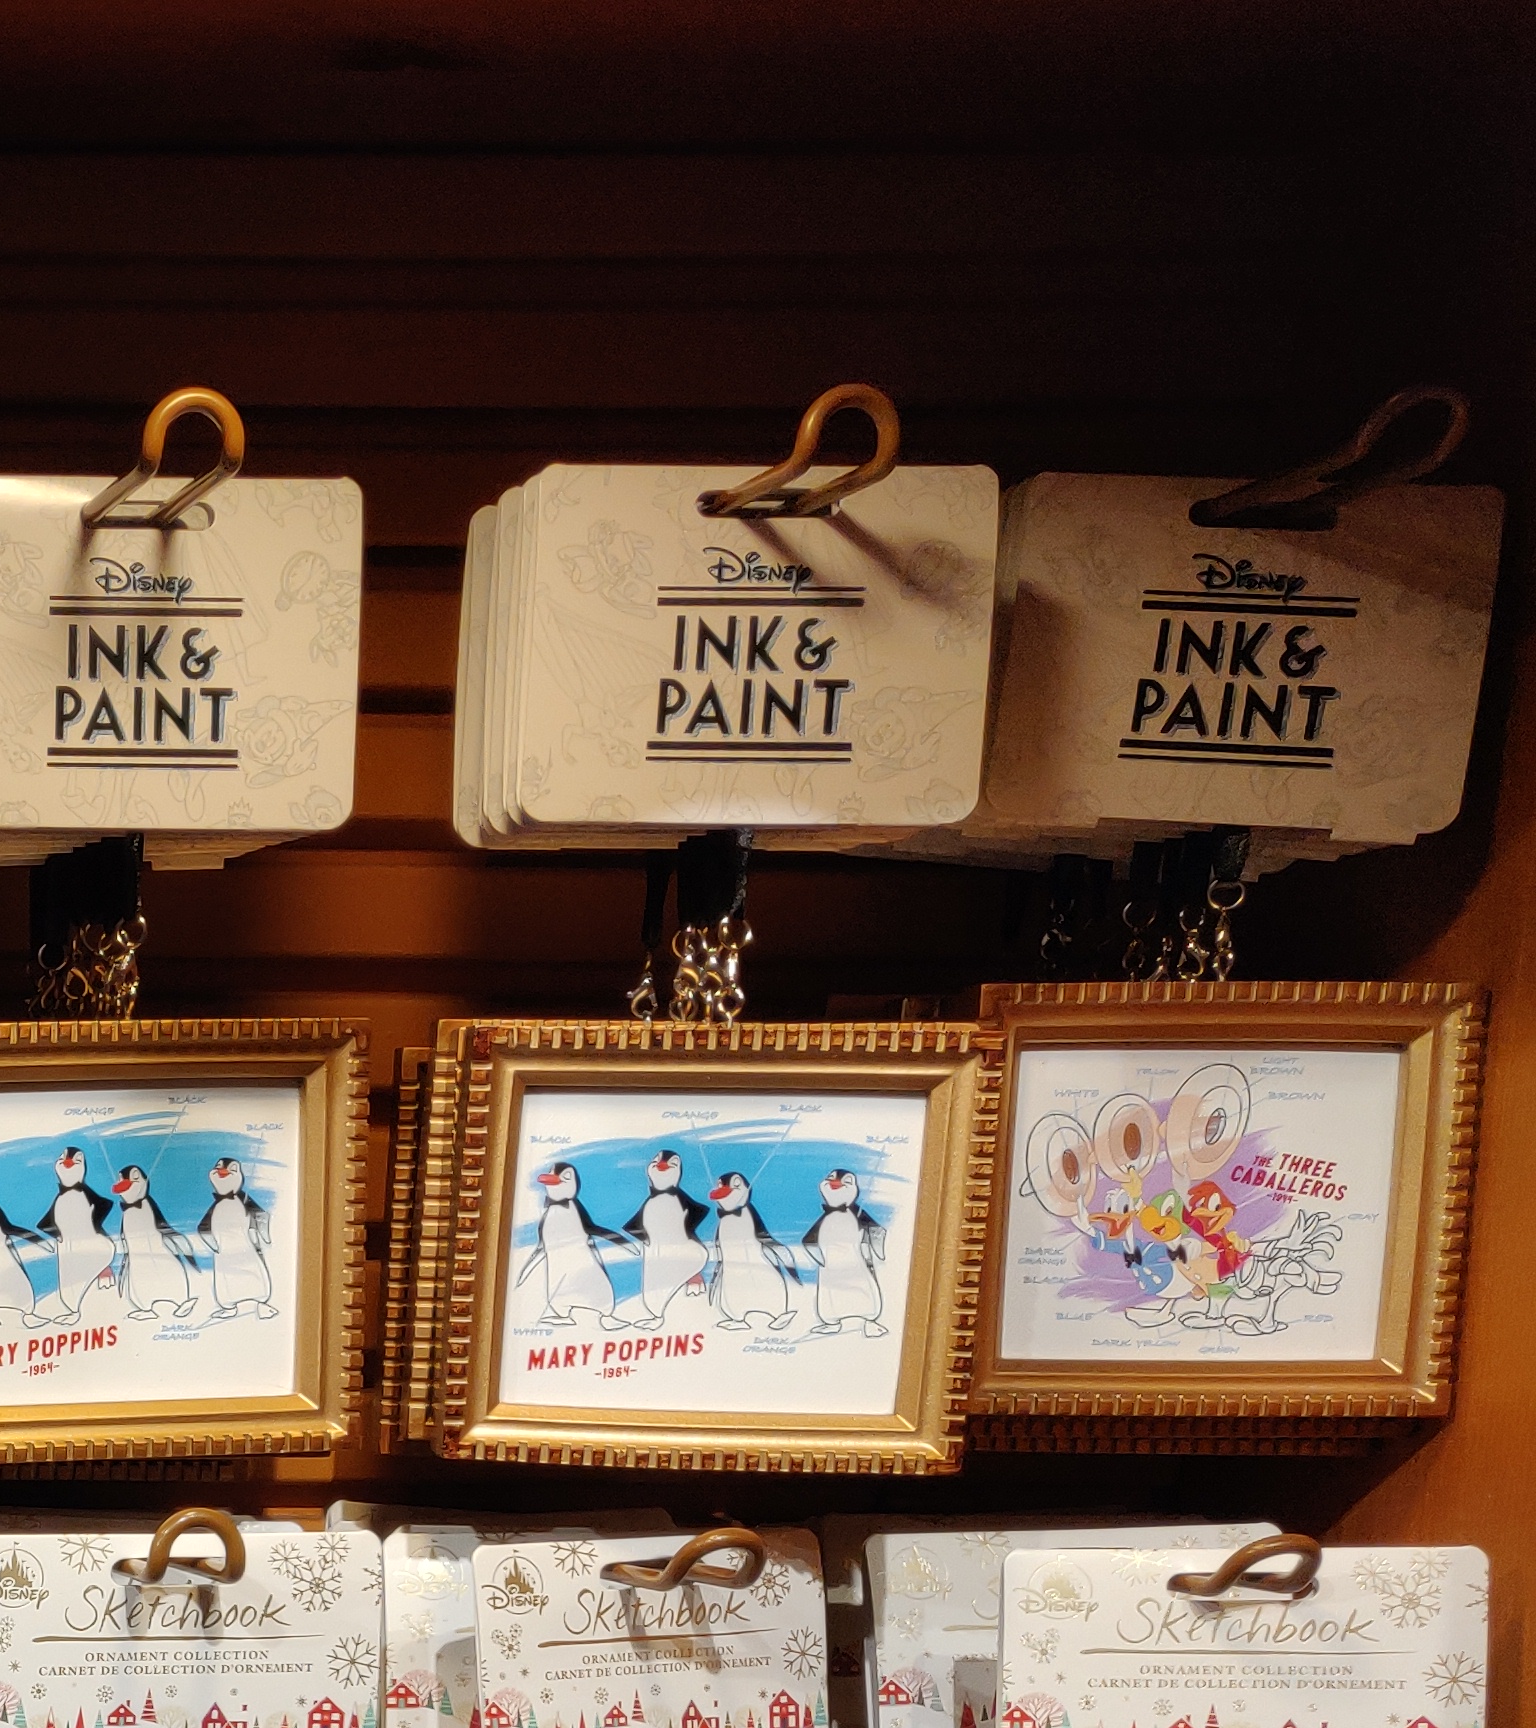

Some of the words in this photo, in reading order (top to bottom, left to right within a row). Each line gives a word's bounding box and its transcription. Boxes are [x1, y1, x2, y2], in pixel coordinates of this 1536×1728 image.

[68, 624, 171, 683] INK
[180, 627, 222, 681] &
[674, 615, 788, 675] INK
[794, 618, 839, 672] &
[1153, 618, 1276, 679] INK
[1279, 625, 1328, 679] &
[55, 686, 238, 744] PAINT
[656, 678, 855, 737] PAINT
[1131, 678, 1341, 741] PAINT
[1230, 1165, 1348, 1201] CABALLEROS
[1253, 1155, 1273, 1168] THE
[1279, 1153, 1337, 1178] THREE
[27, 1325, 118, 1361] POPPINS
[528, 1343, 594, 1371] MARY
[603, 1333, 705, 1363] POPPINS
[65, 1584, 292, 1631] Sketchbook
[563, 1587, 751, 1636] Sketchbook
[1117, 1596, 1380, 1646] Sketchbook
